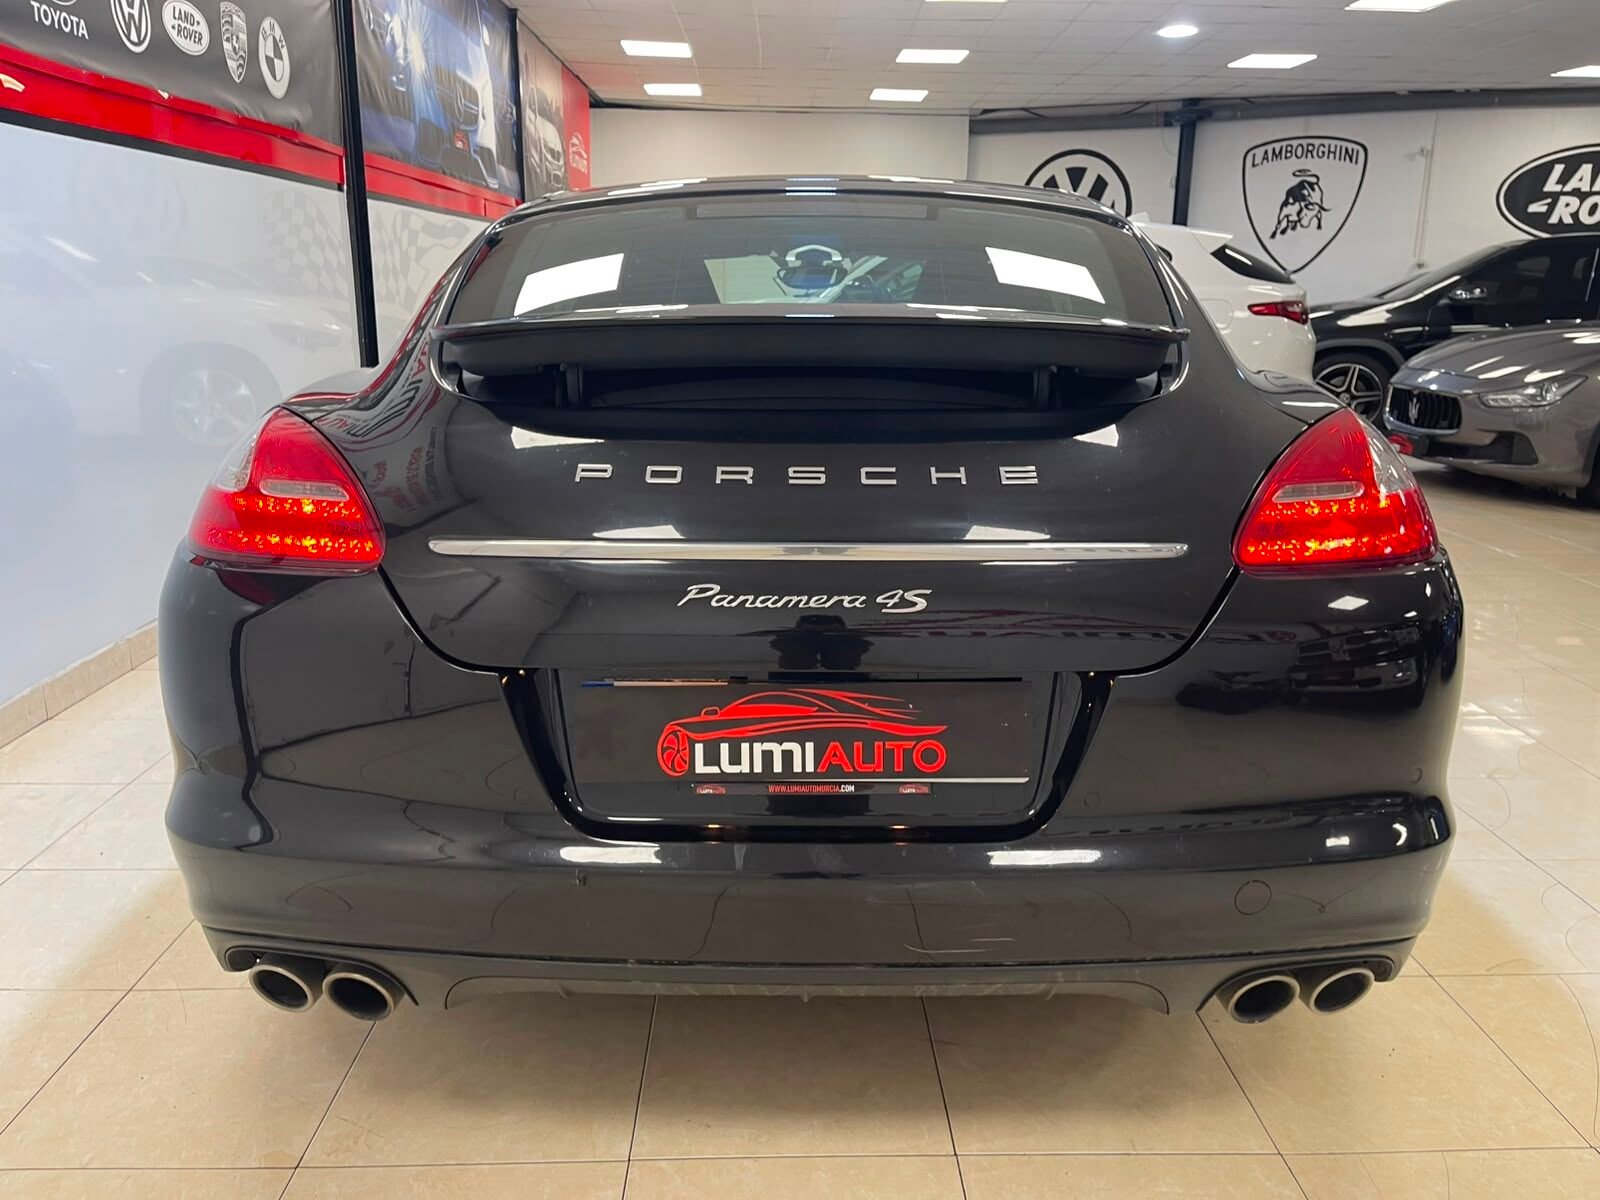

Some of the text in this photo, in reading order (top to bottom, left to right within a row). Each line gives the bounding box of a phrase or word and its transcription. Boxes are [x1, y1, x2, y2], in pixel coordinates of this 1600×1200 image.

[30, 1, 89, 40] TOYOTA
[172, 5, 195, 27] LAND
[177, 24, 203, 47] ROVER
[1251, 142, 1360, 168] LAMBORGHINI
[1542, 163, 1600, 193] LA
[574, 463, 1040, 486] PORSCHE
[676, 583, 933, 614] Panamera 4S
[767, 784, 855, 793] WWW.LUMIAUTOMURCIA.COM
